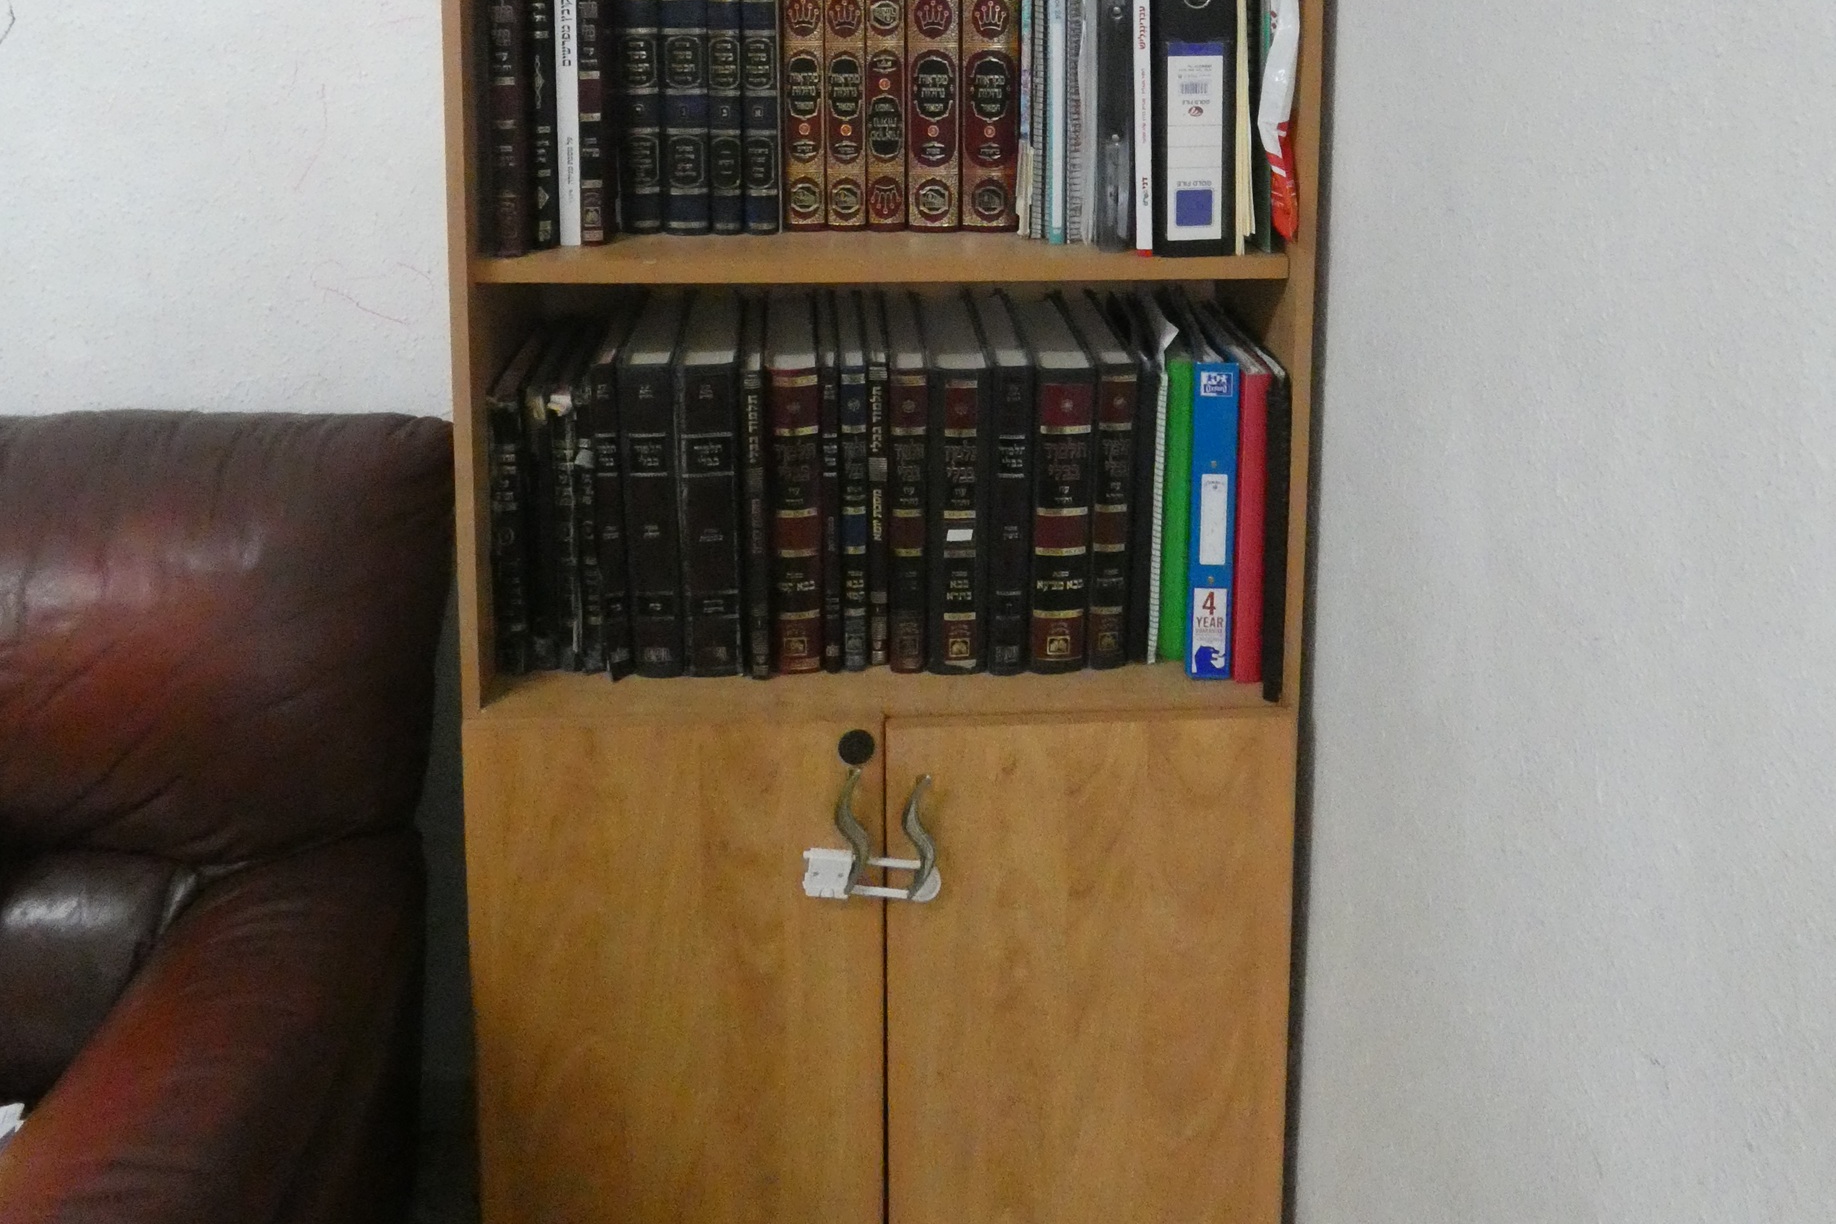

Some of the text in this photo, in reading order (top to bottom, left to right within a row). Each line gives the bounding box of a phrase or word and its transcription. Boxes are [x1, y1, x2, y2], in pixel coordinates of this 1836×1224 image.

[560, 24, 573, 67] מפרשים
[870, 386, 882, 423] תלמוד
[1202, 591, 1217, 616] 4
[1196, 616, 1224, 628] YEAR
